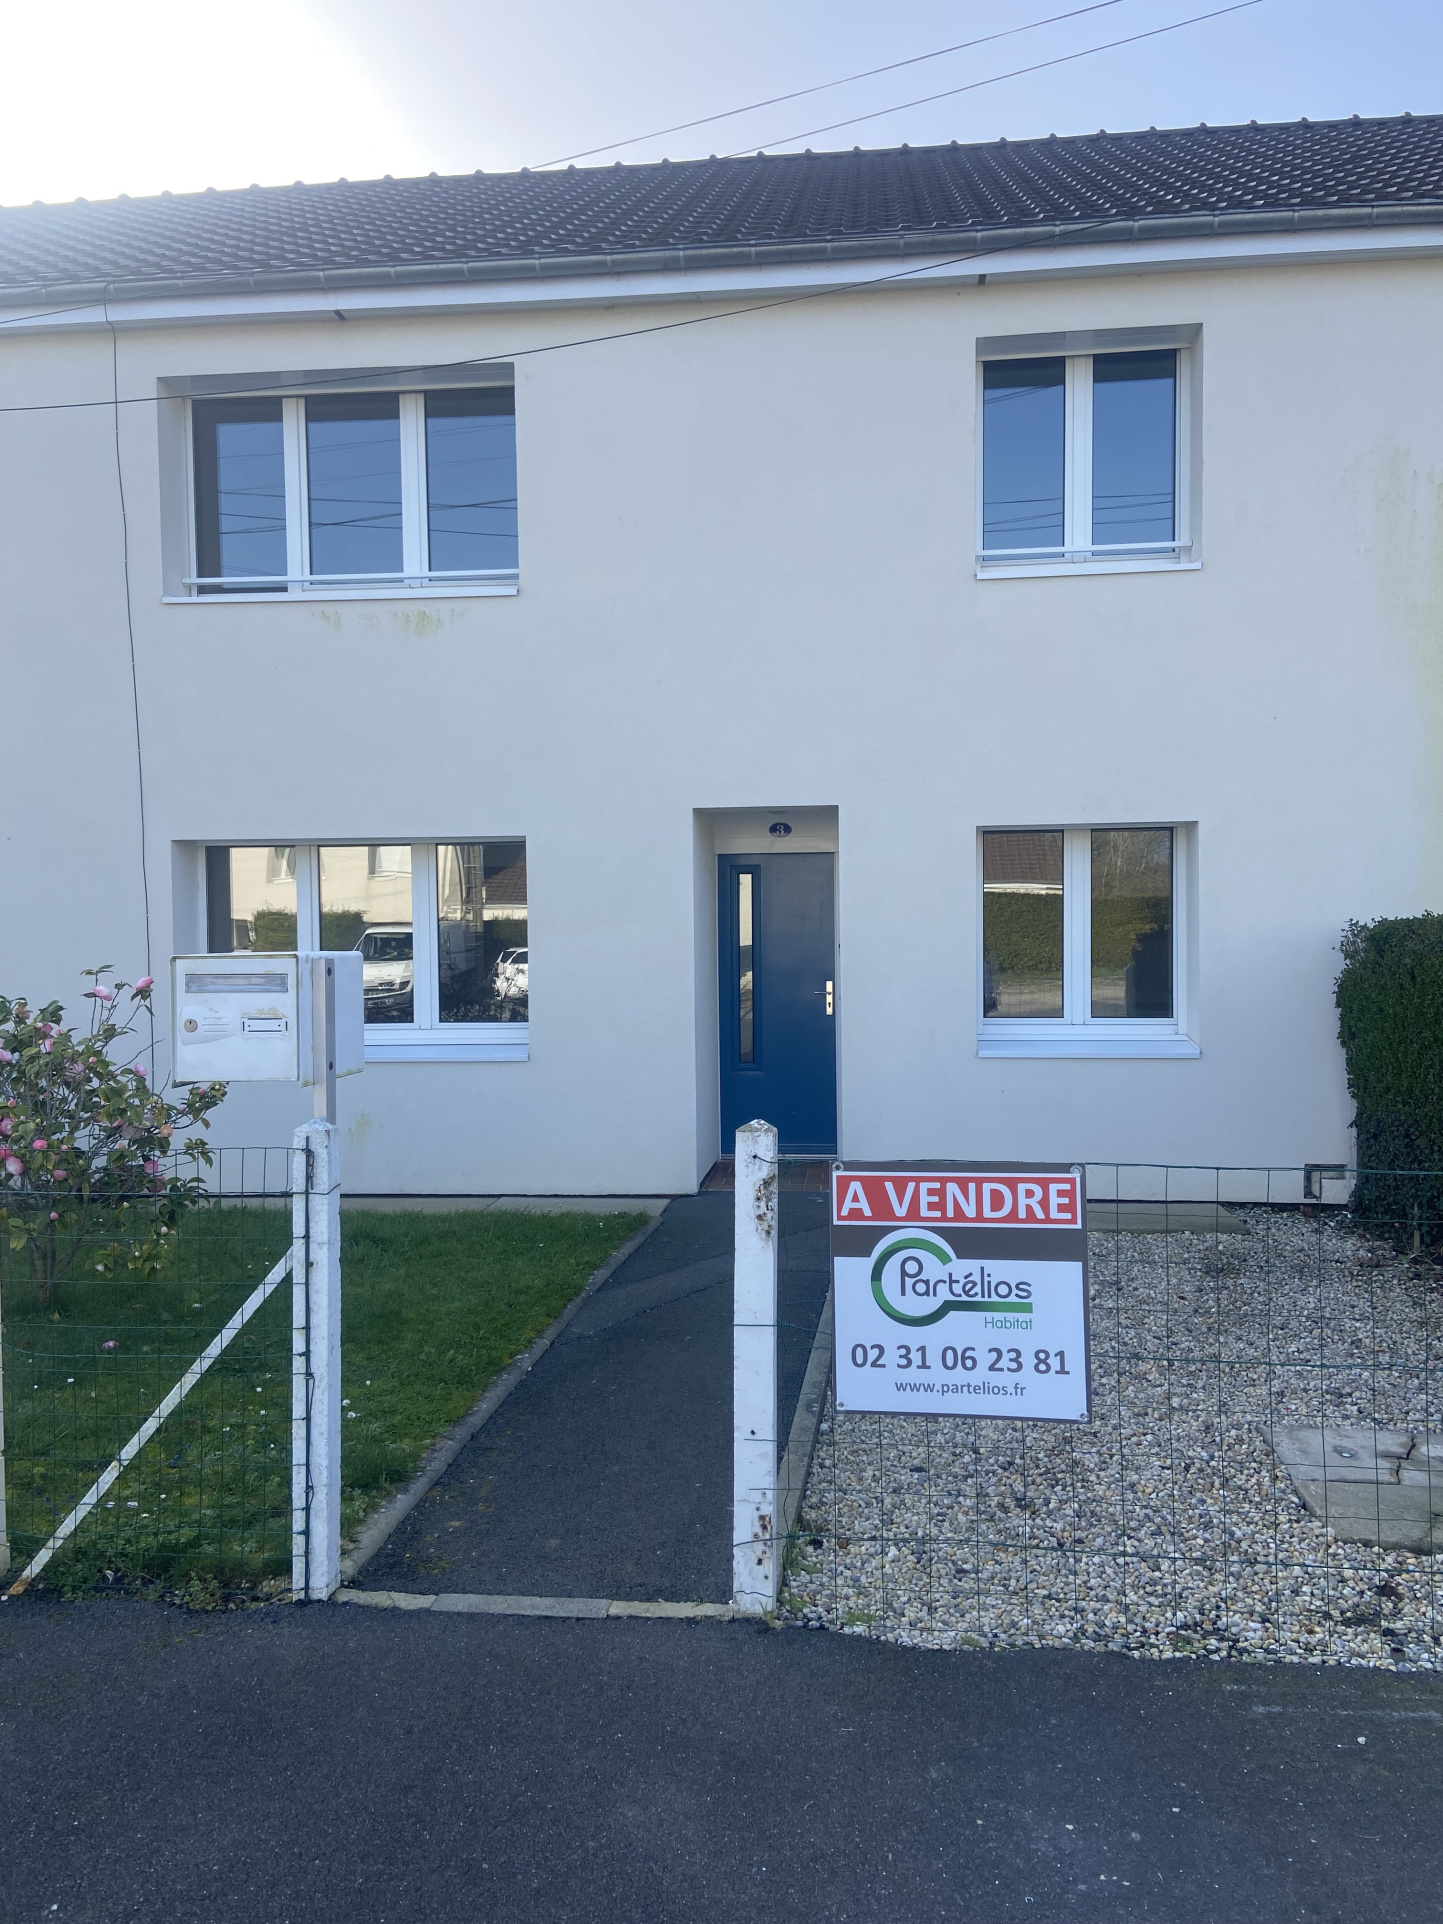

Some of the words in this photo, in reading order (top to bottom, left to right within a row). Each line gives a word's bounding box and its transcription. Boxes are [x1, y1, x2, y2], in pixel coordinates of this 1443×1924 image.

[775, 824, 785, 835] 3
[840, 1181, 873, 1217] A
[884, 1181, 1073, 1220] VENDRE
[900, 1255, 1033, 1300] Partélios
[984, 1316, 1033, 1331] Habitat
[850, 1343, 887, 1369] 02
[896, 1344, 932, 1370] 31
[941, 1346, 978, 1371] 06
[987, 1347, 1024, 1373] 23
[1033, 1349, 1071, 1375] 81
[894, 1380, 1027, 1397] www.partelios.fr
